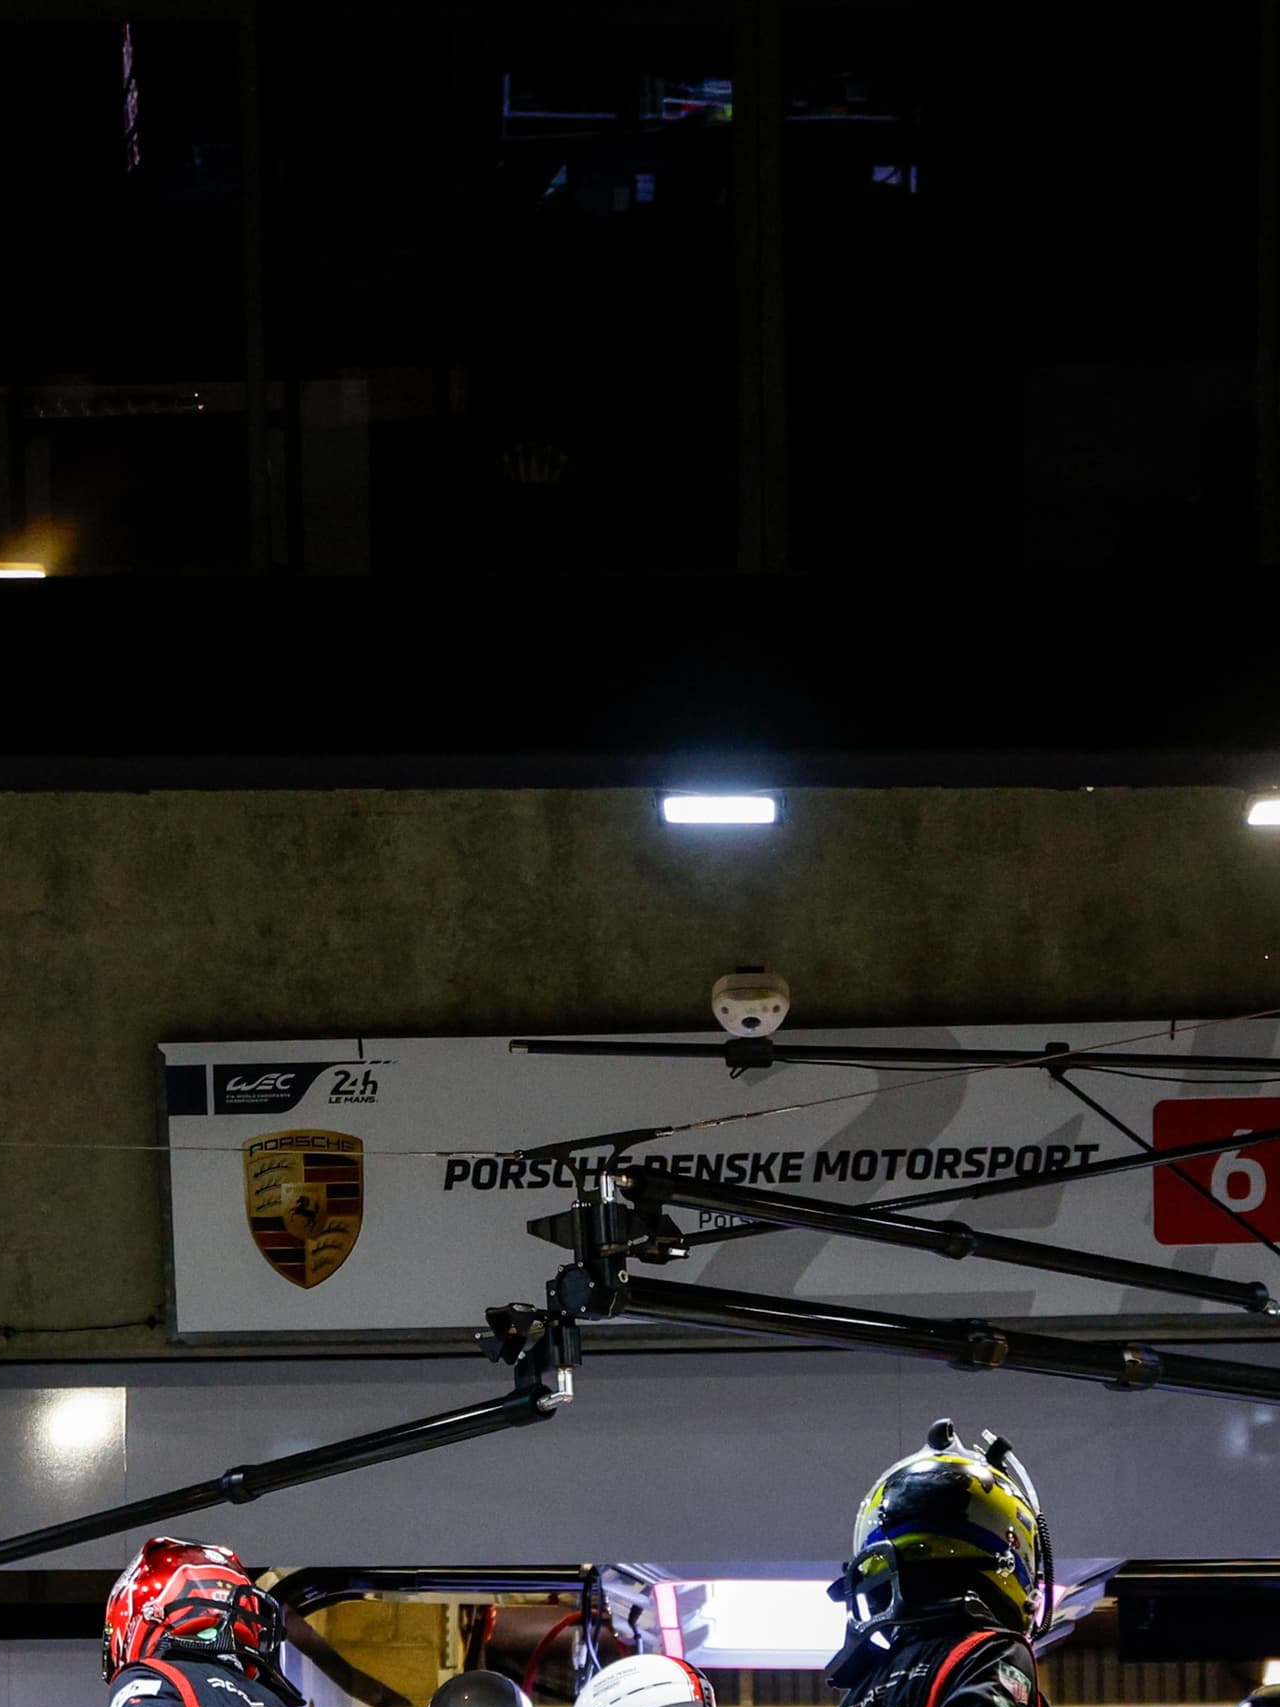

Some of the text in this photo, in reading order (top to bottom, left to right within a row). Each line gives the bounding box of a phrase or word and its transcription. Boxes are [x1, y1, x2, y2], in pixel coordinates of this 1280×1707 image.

[226, 1073, 296, 1092] WEC
[249, 1135, 355, 1158] PORSCHE
[813, 1144, 1100, 1183] MOTORSPORT
[1210, 1128, 1267, 1214] 6
